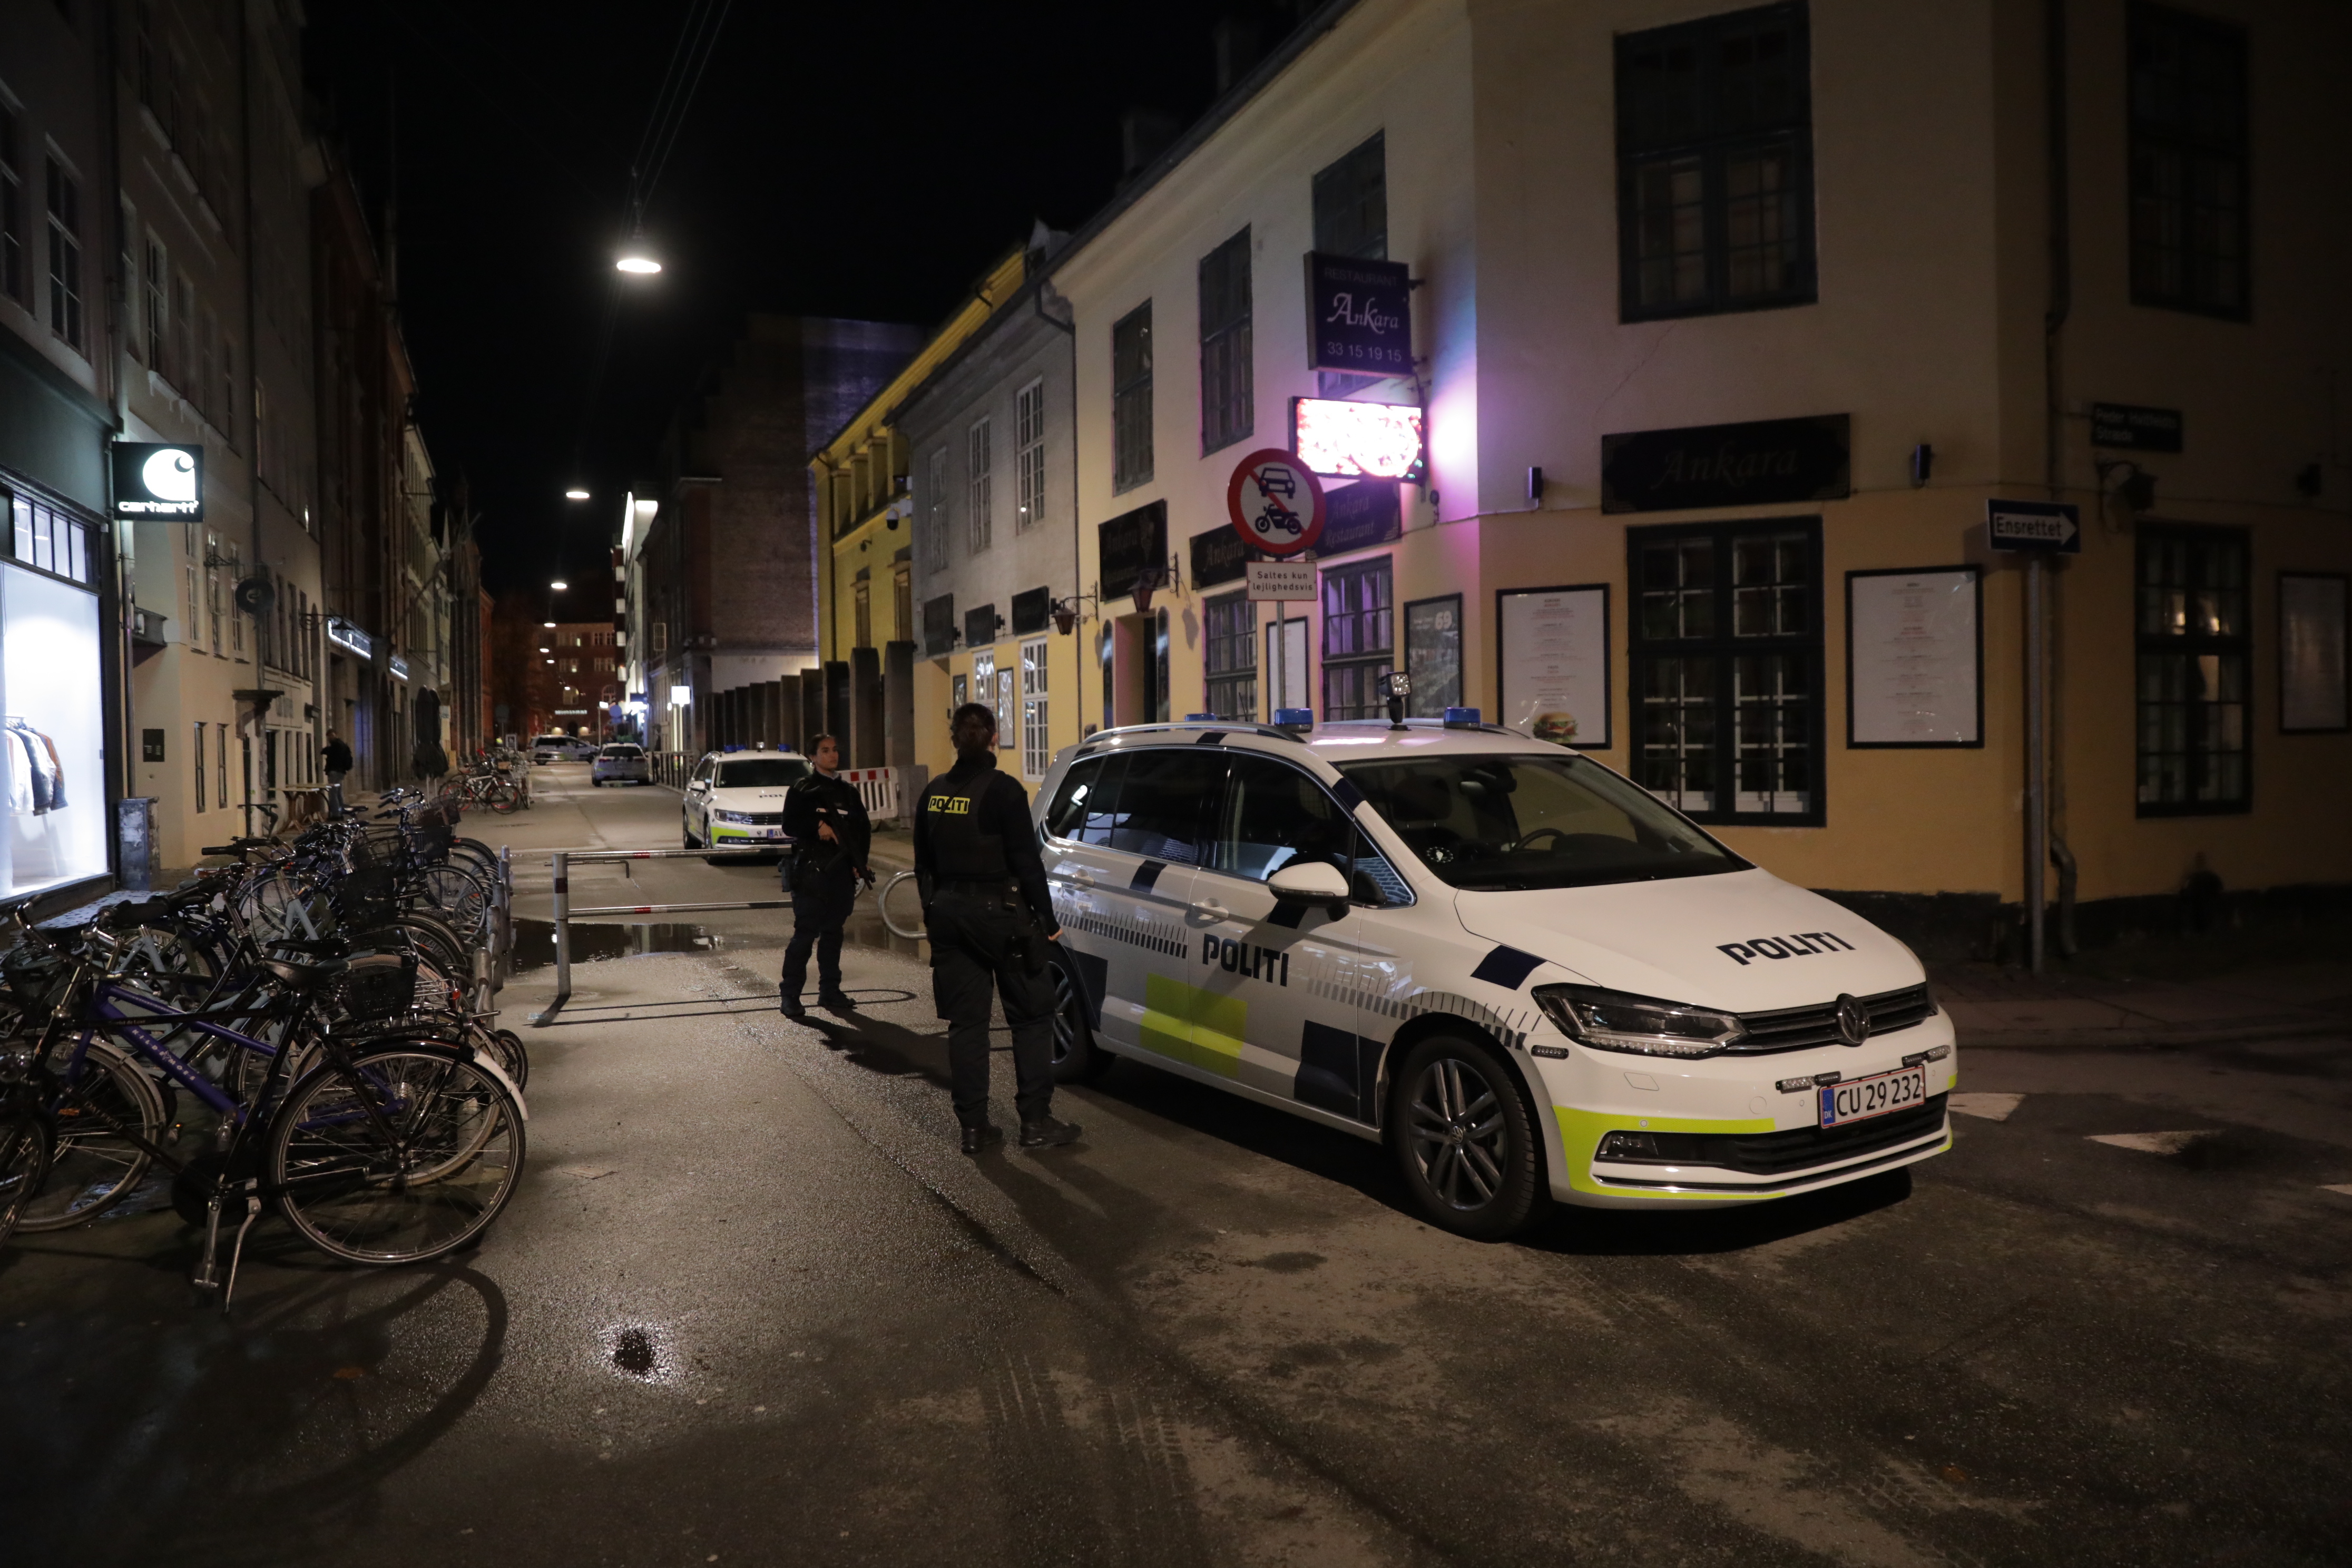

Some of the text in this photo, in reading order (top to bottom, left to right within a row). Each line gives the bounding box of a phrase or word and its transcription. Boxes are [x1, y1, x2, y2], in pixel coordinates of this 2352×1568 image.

[1324, 267, 1397, 287] RESTAURANT
[1327, 292, 1399, 335] Ankara
[1327, 341, 1402, 362] 33 15 19 15
[1649, 439, 1799, 491] Ankara
[1996, 515, 2062, 537] Ensrettet
[1203, 535, 1245, 573] Ankara
[1253, 582, 1313, 592] lejlighedsvis
[1202, 933, 1289, 987] POLITI
[1716, 932, 1856, 965] POLITI
[1836, 1073, 1921, 1116] CU 29 232
